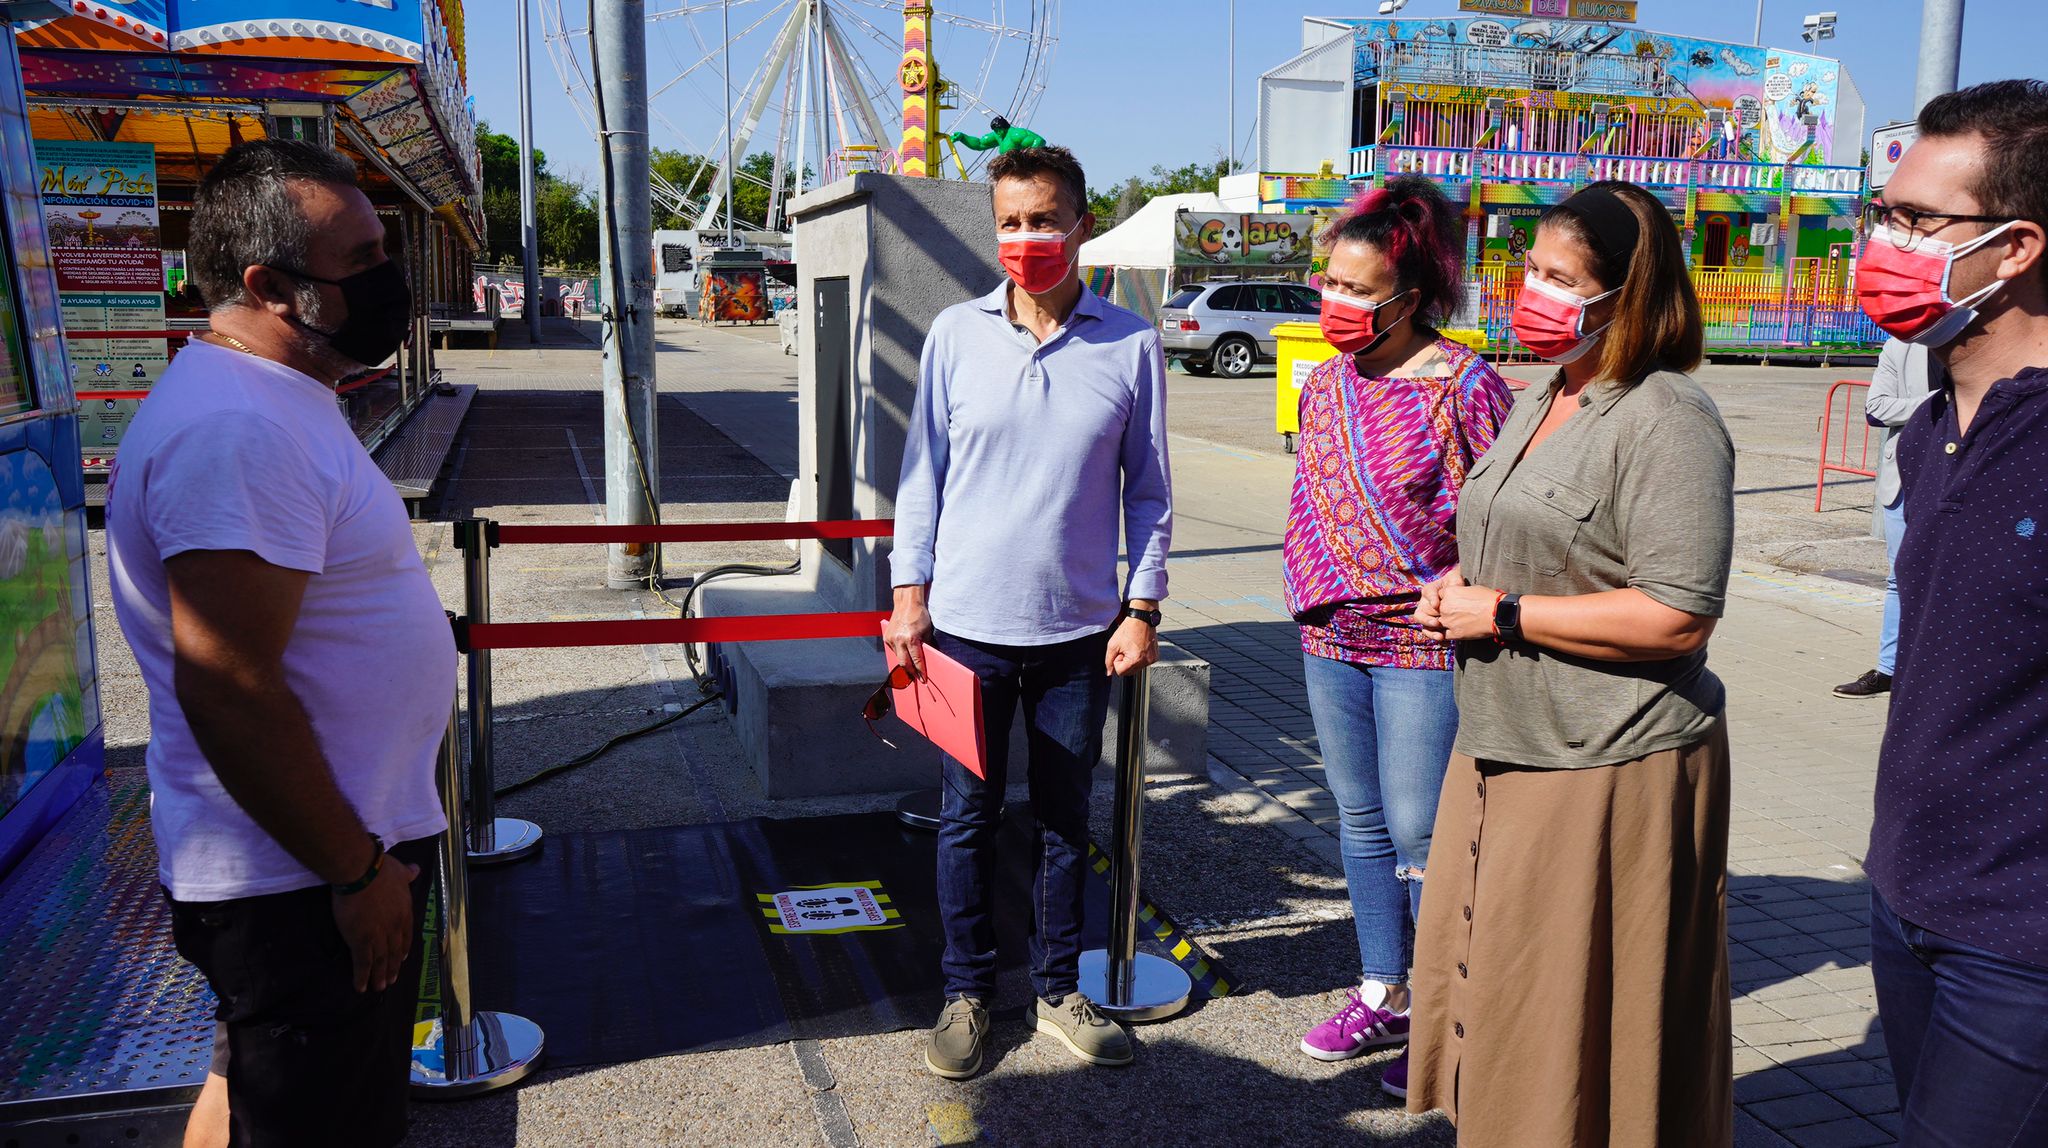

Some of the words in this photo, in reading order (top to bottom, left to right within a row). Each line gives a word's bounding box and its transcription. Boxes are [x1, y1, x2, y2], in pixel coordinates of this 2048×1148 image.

[1537, 0, 1561, 13] DEL
[1576, 3, 1631, 19] HUMOR
[1530, 91, 1556, 109] DEL
[41, 166, 92, 197] Mini
[97, 167, 154, 195] Pista
[110, 199, 154, 207] COVID-19
[1497, 208, 1541, 216] DIVERSION
[107, 297, 118, 305] ASÍ
